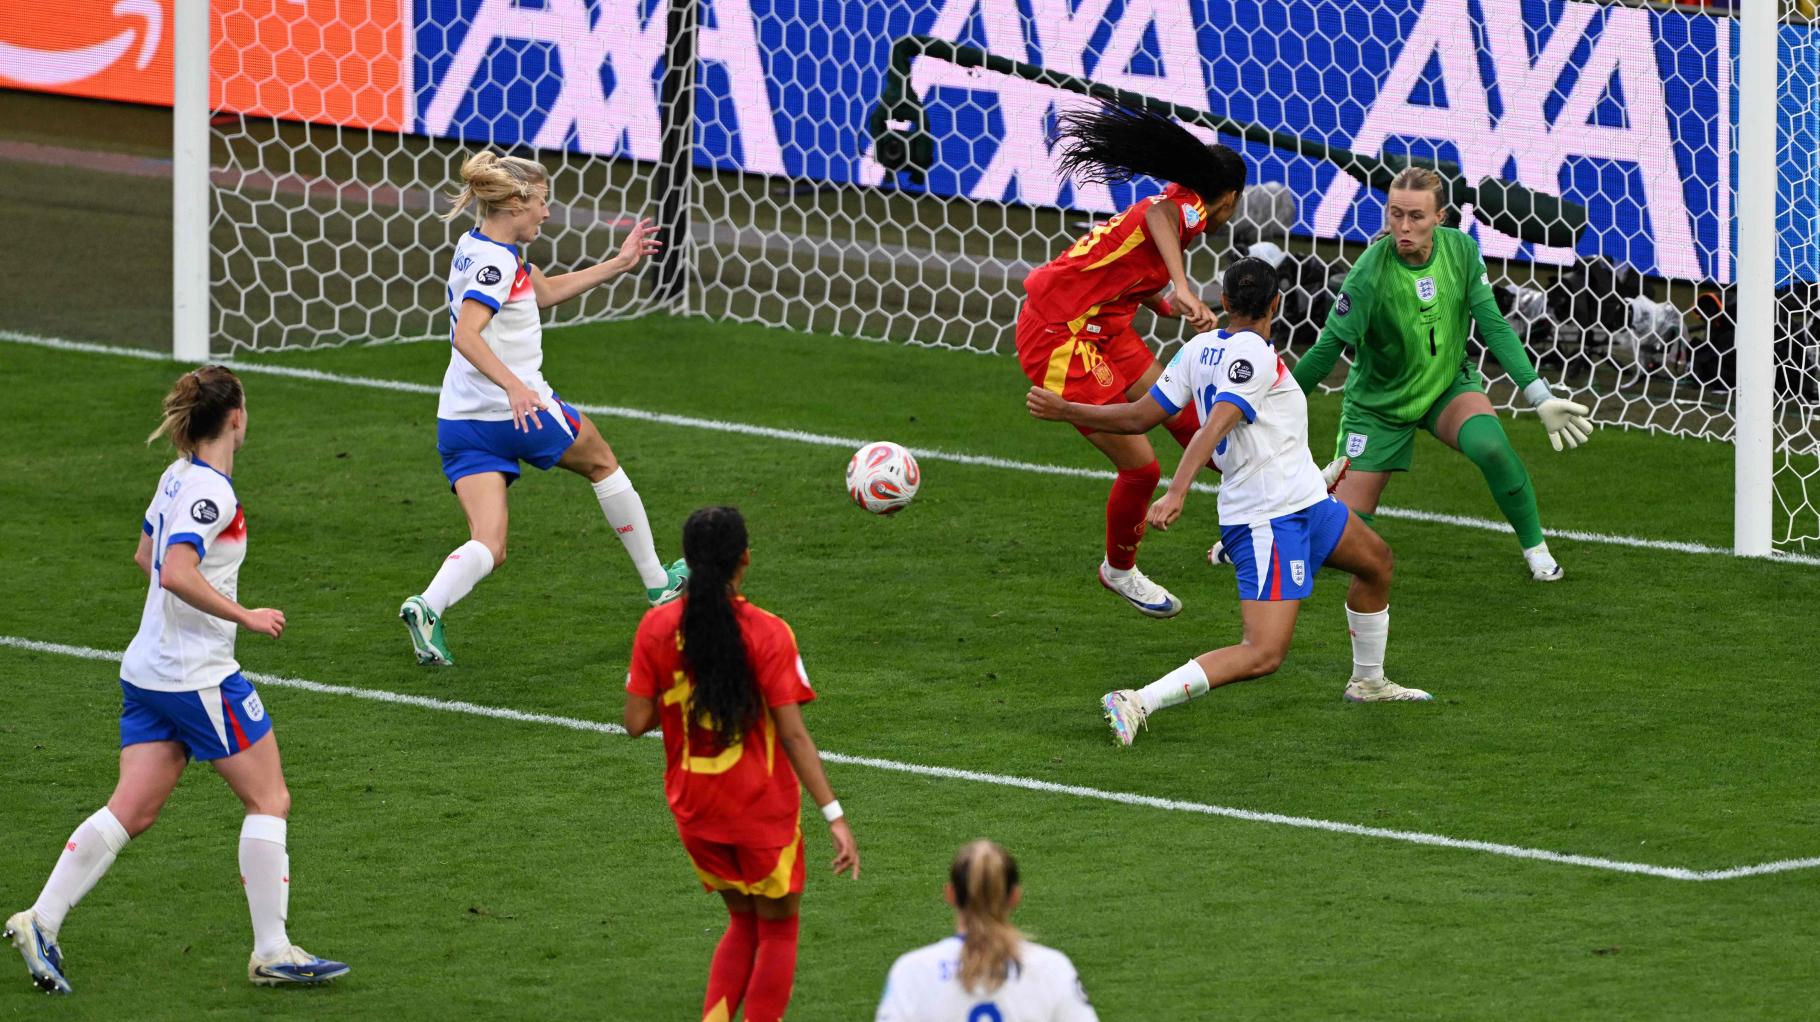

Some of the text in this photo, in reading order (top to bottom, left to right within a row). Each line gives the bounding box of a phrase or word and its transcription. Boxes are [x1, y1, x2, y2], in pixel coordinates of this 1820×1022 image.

[425, 0, 787, 176] AXA
[858, 0, 1219, 212] AXA
[1313, 0, 1704, 282] AXA
